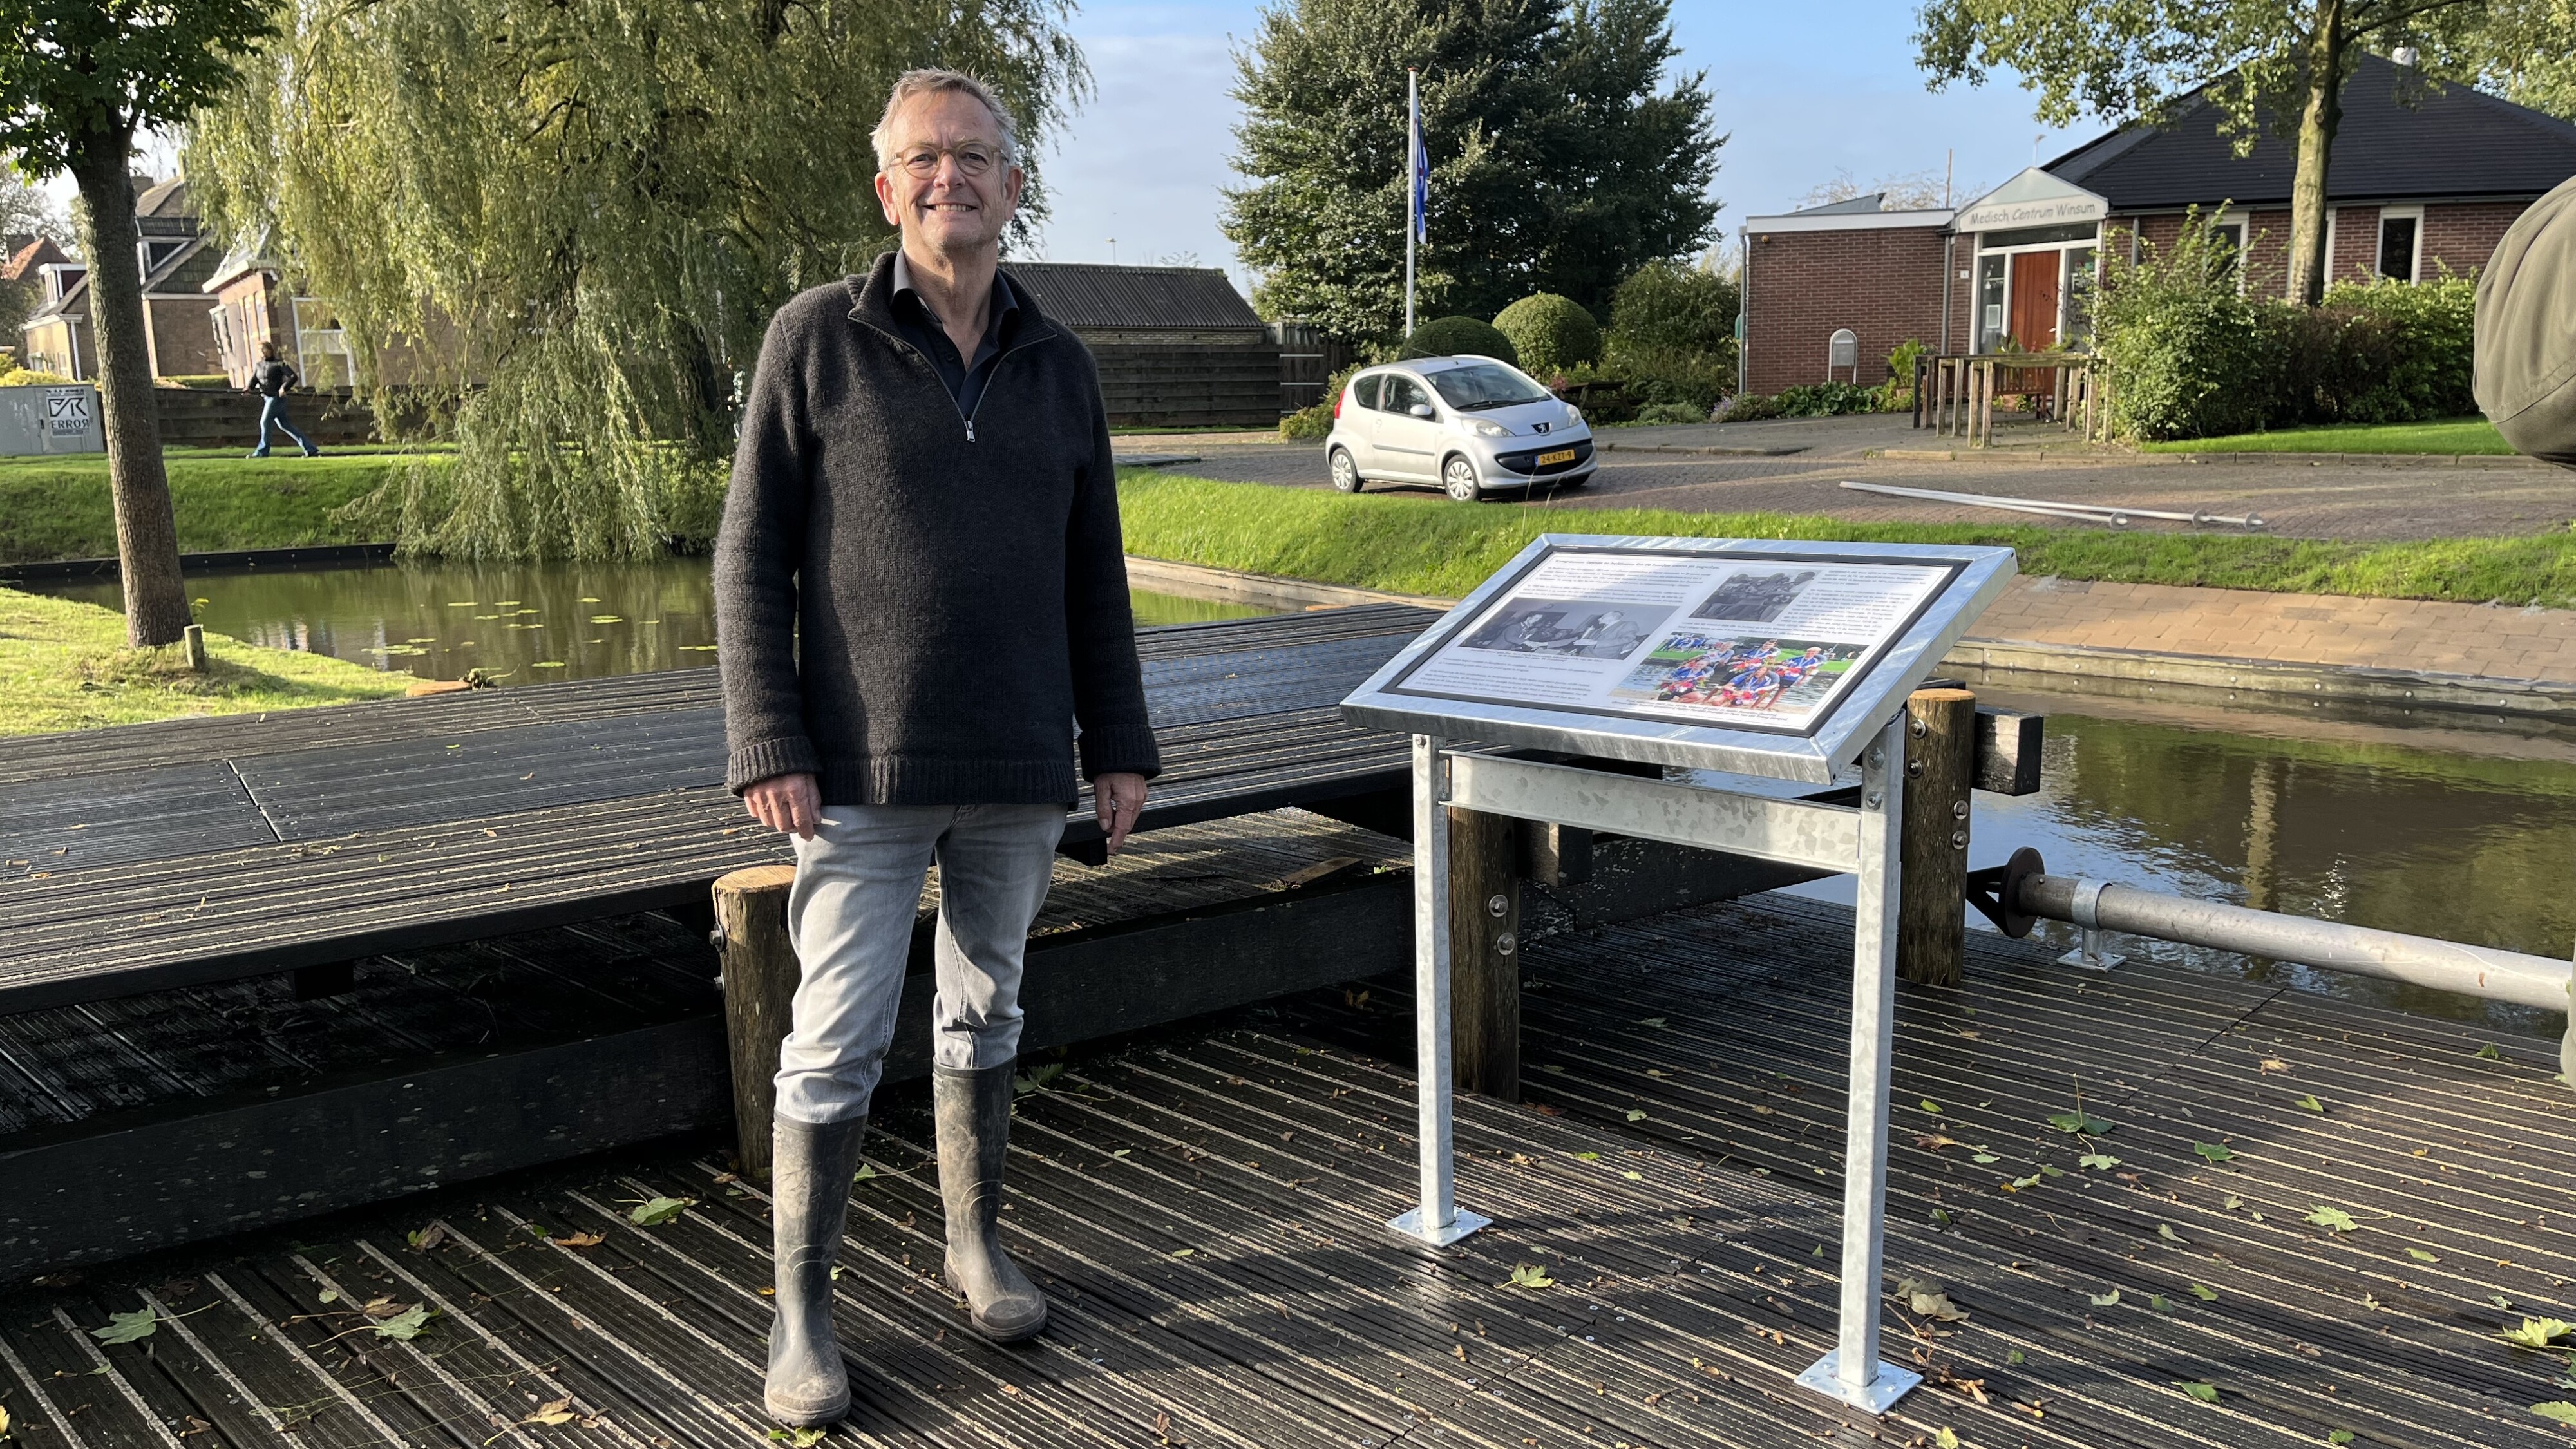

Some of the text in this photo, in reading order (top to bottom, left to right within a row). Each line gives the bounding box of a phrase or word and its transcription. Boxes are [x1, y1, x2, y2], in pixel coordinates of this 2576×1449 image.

[1970, 204, 2096, 225] Medisch Centrum Winsum
